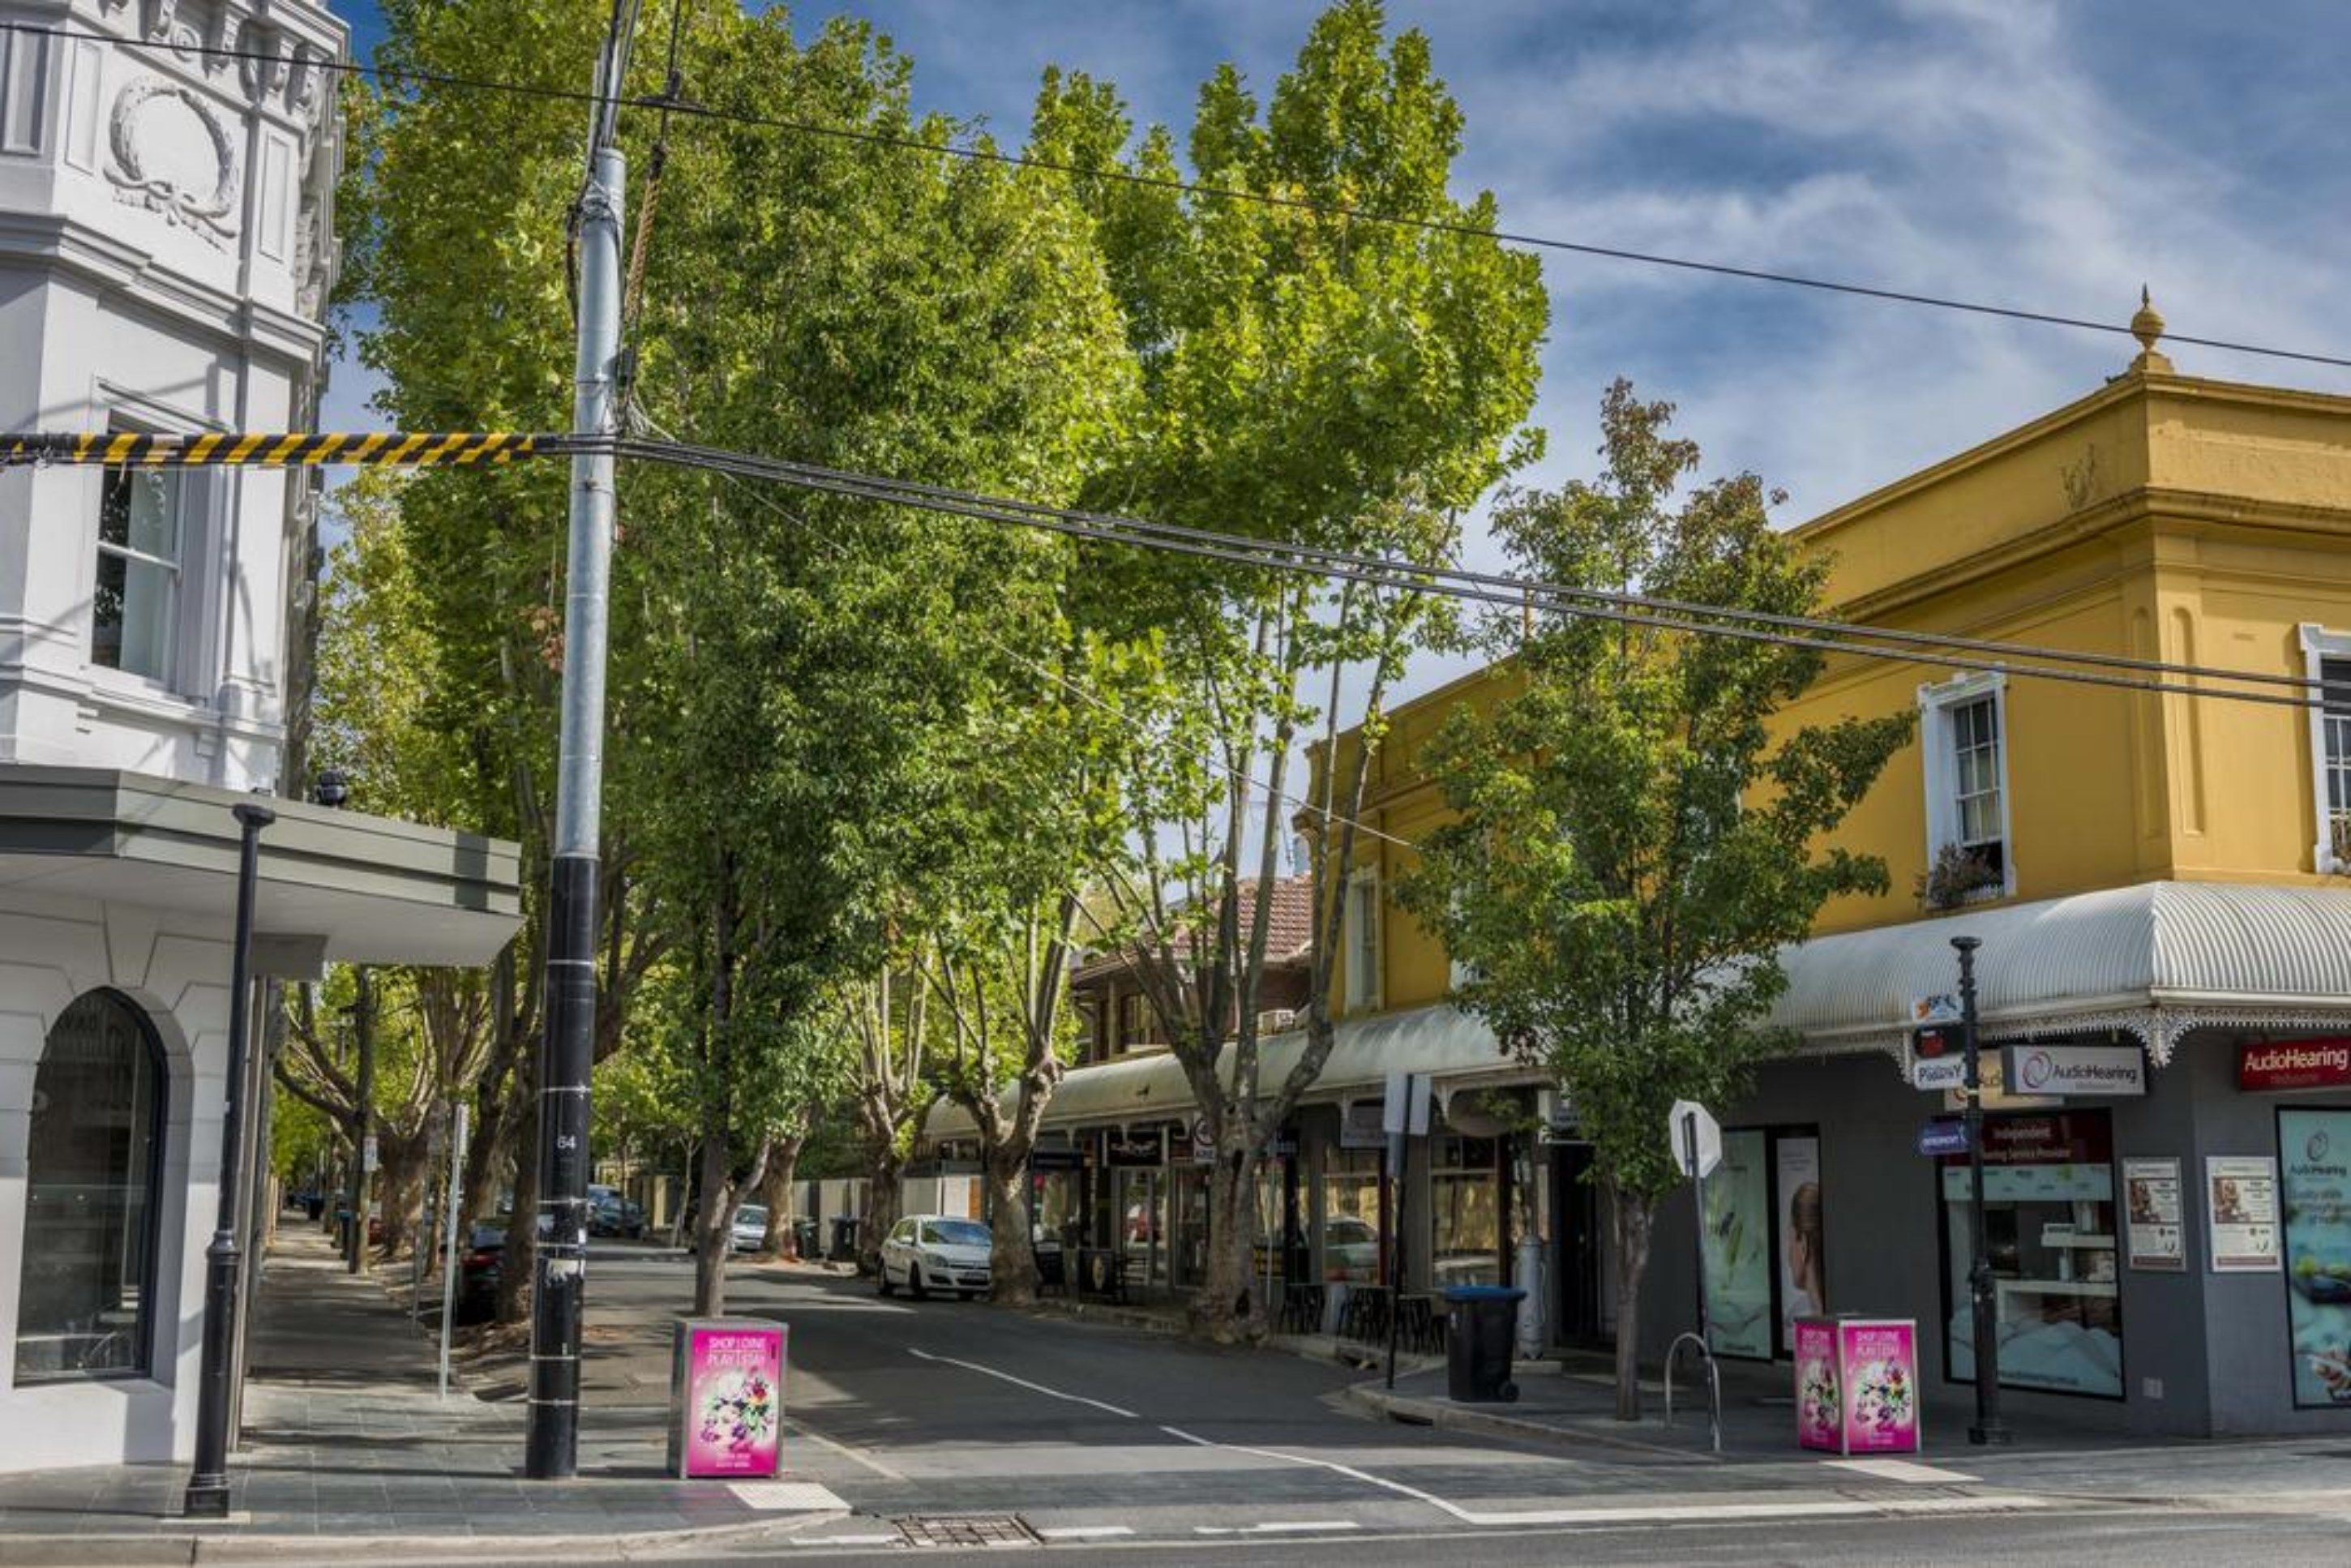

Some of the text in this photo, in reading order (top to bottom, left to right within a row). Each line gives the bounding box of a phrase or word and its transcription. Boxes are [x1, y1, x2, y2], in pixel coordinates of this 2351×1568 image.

[2244, 1046, 2349, 1071] AudioHearing
[2053, 1064, 2138, 1083] AudioHearing
[709, 1337, 735, 1349] SHOP
